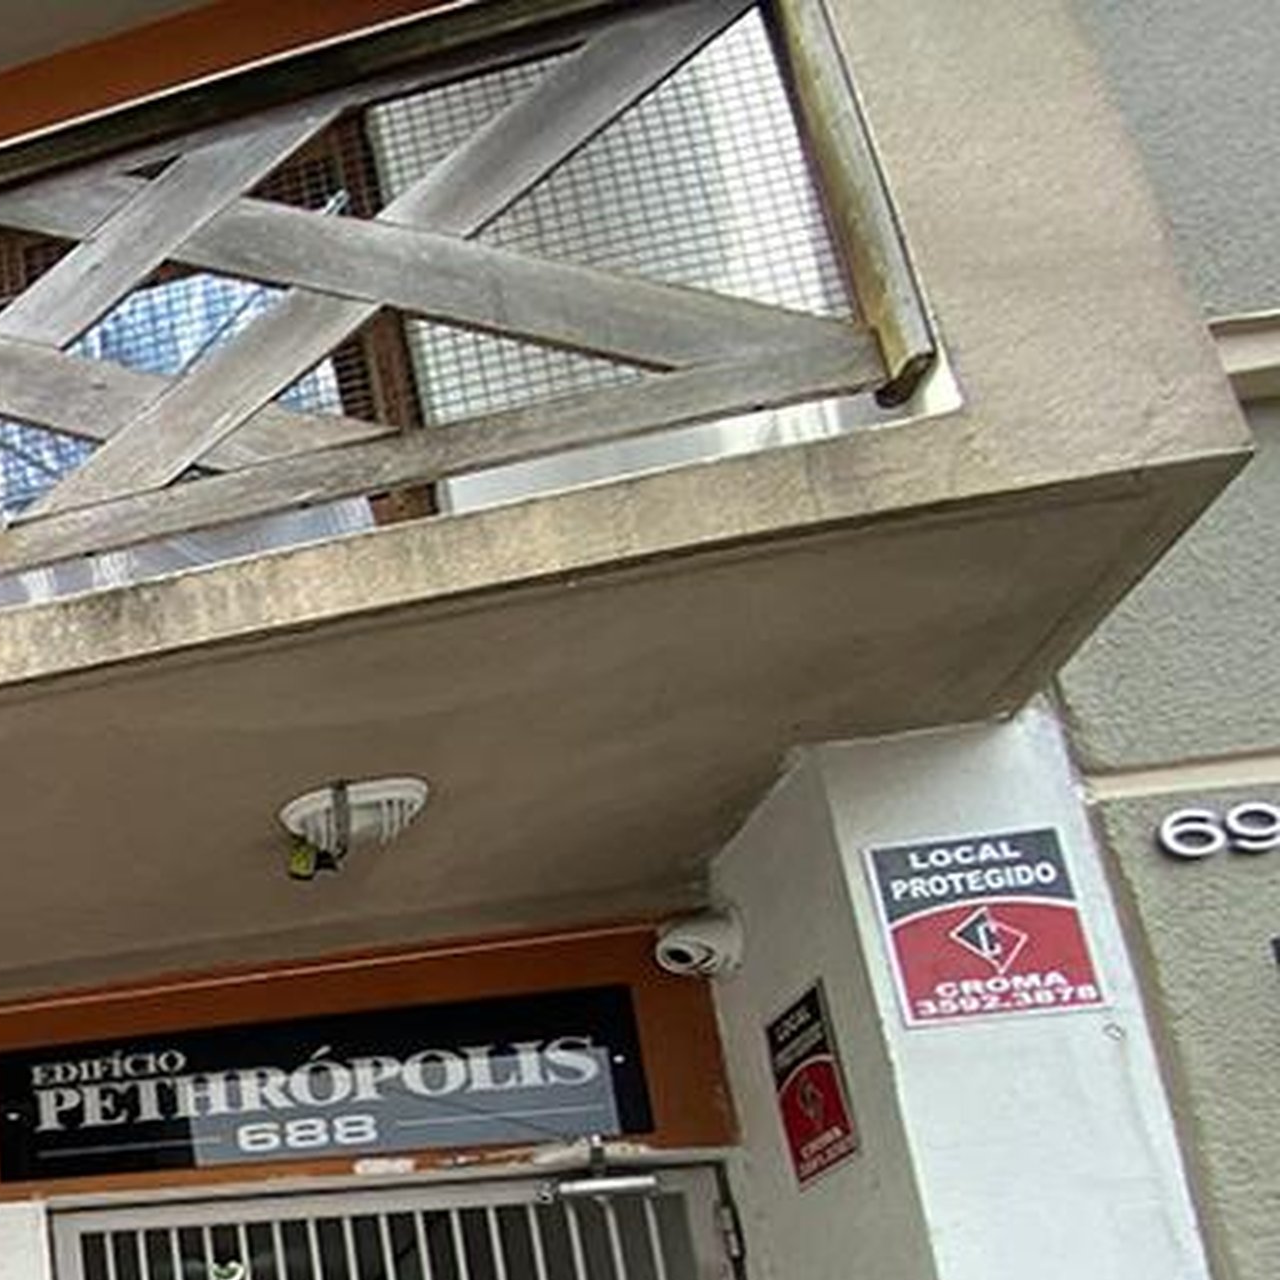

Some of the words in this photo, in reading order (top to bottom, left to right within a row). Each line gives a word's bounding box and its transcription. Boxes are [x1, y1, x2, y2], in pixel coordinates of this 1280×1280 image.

[908, 841, 1023, 869] LOCAL
[891, 861, 1058, 901] PROTEGIDO
[934, 971, 1069, 999] CROMA
[33, 1036, 600, 1134] PETHRÓPOLIS
[237, 1114, 378, 1153] 688
